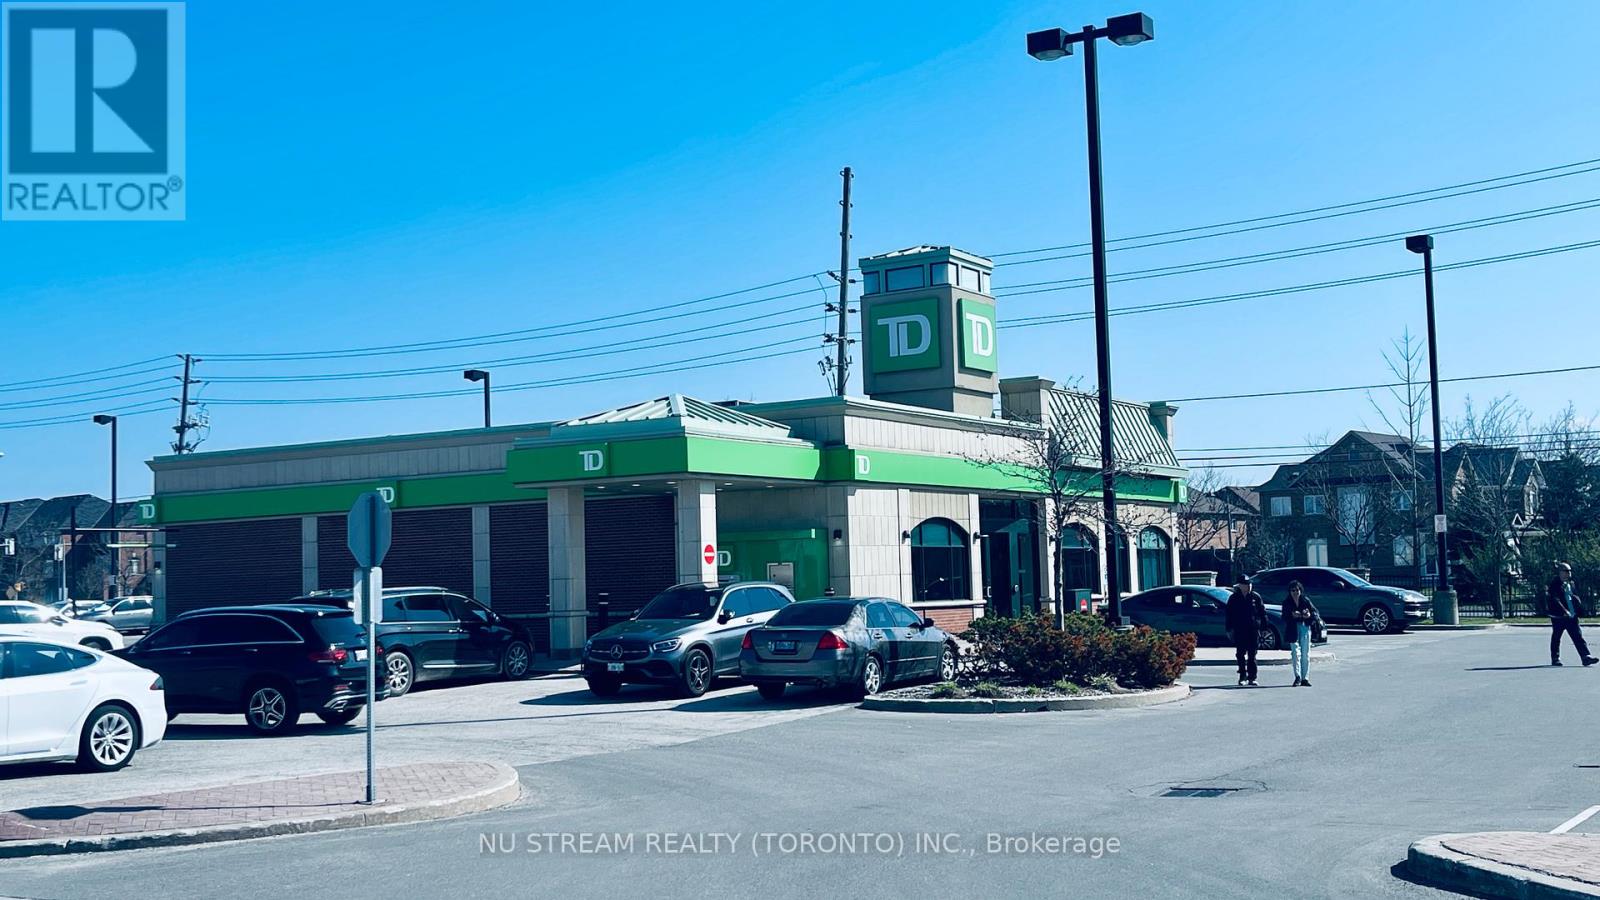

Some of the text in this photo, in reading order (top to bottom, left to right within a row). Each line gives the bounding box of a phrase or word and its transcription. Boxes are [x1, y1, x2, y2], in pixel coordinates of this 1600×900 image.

[877, 314, 932, 358] TD
[965, 312, 994, 357] TD
[578, 450, 604, 471] TD
[855, 454, 871, 475] TD
[139, 504, 155, 519] TD
